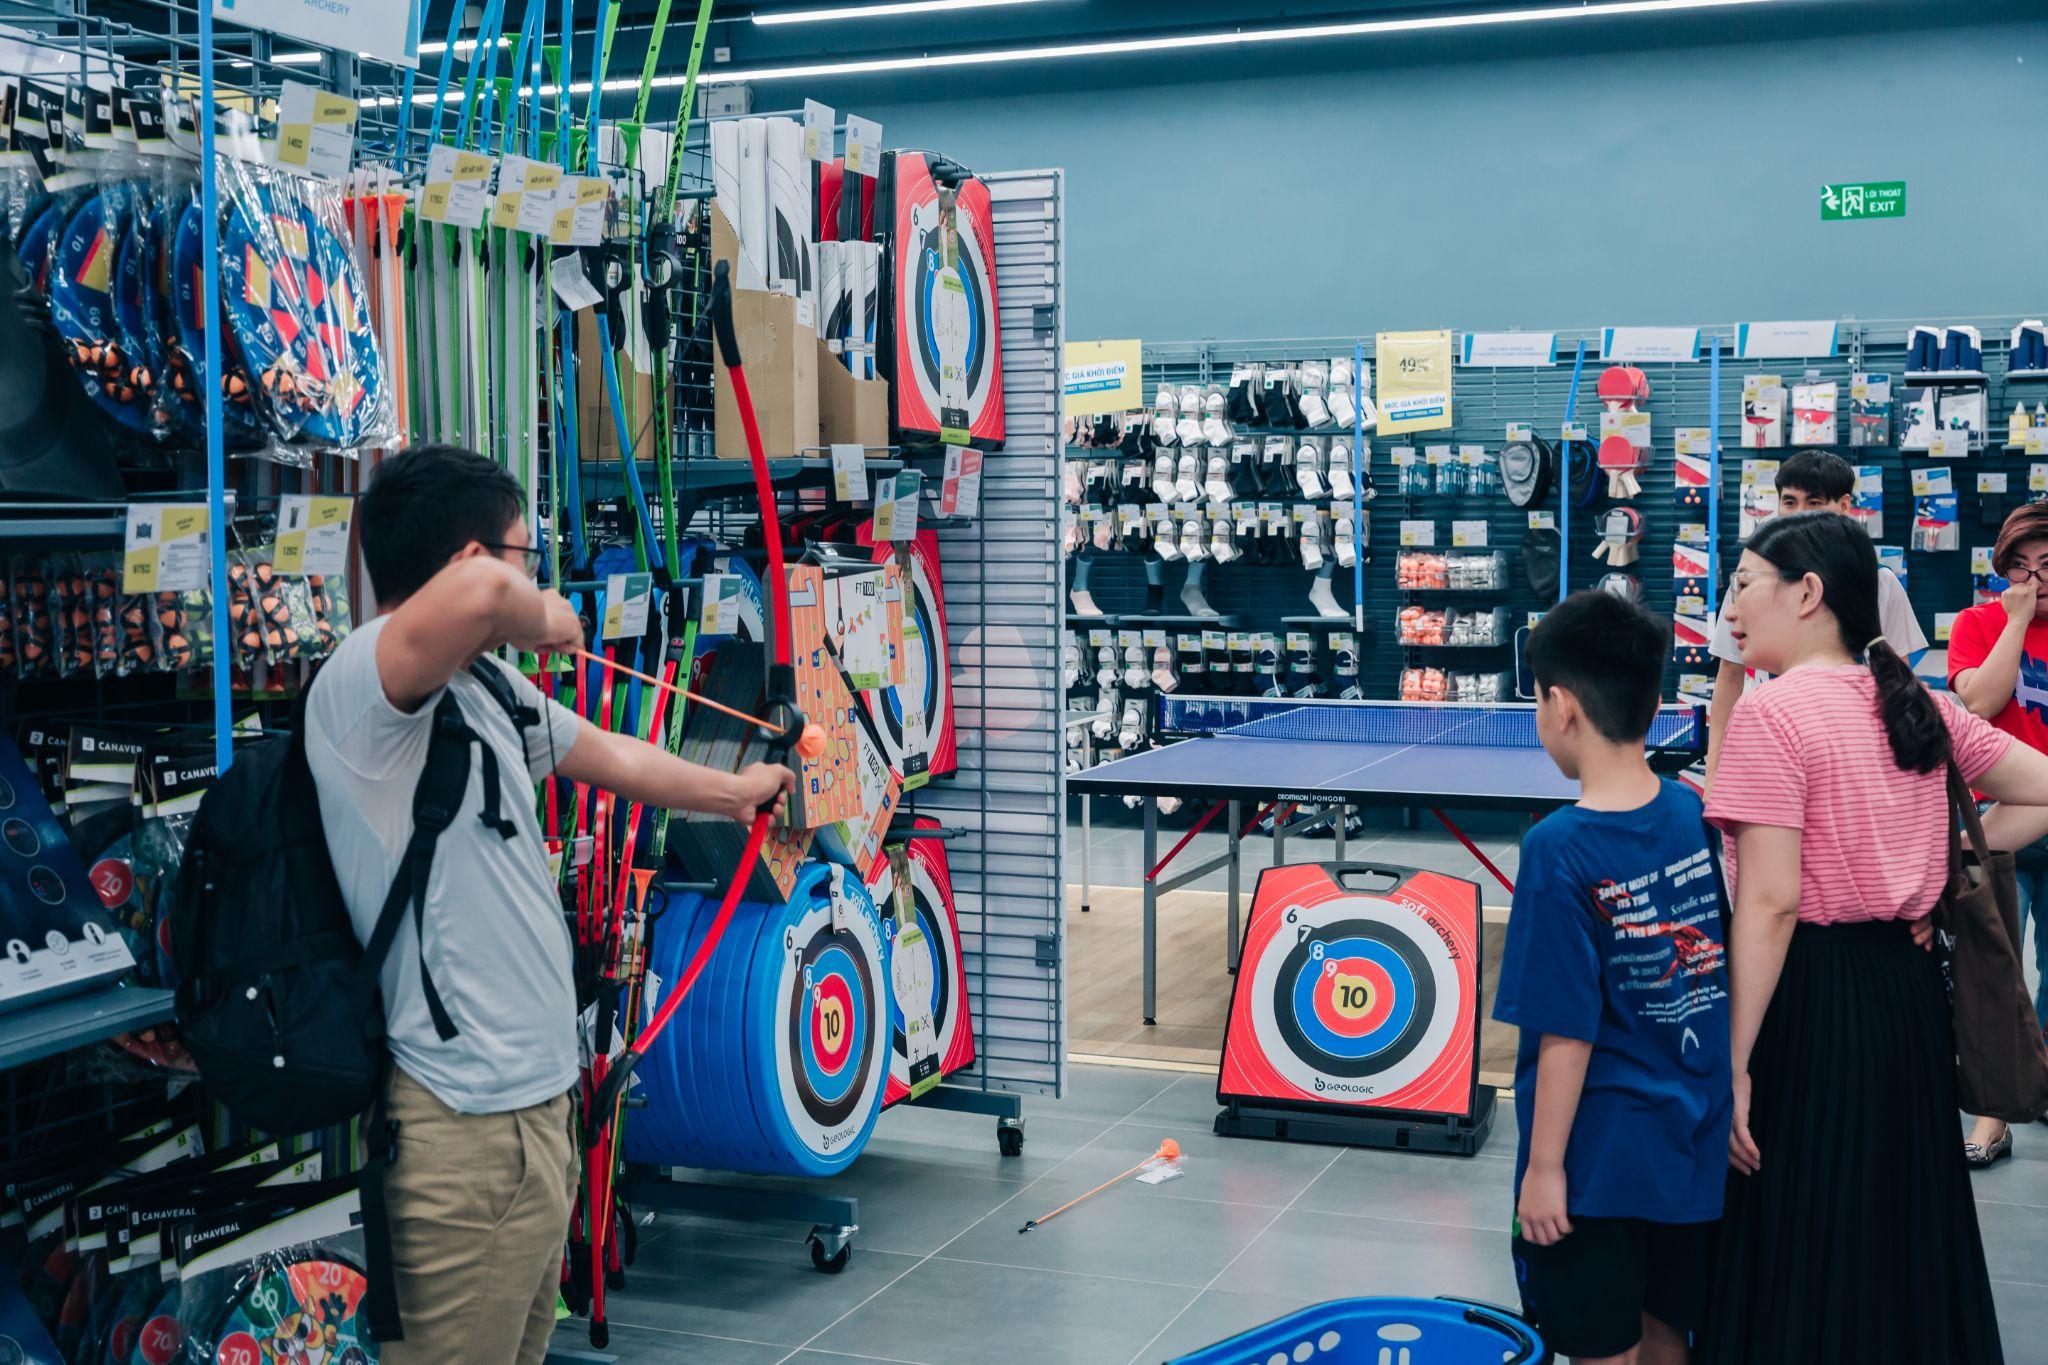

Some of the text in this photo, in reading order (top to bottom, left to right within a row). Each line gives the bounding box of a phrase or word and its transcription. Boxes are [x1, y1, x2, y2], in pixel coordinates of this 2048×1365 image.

[1869, 201, 1896, 212] EXIT
[913, 207, 919, 226] 6
[71, 234, 84, 251] 10
[921, 231, 926, 250] 7
[929, 252, 934, 271] 8
[181, 283, 190, 300] 10
[855, 582, 874, 595] FT 100
[1313, 795, 1346, 803] PONGORI
[100, 870, 122, 895] 70
[1598, 871, 1659, 900] SPENT MOST OF
[1617, 898, 1631, 910] ITS
[1286, 908, 1297, 924] 6
[850, 892, 885, 961] soft archery
[884, 921, 891, 940] 8
[1300, 926, 1311, 943] 7
[1401, 898, 1461, 961] soft archery
[1615, 929, 1625, 940] IN
[1627, 926, 1646, 938] THE
[786, 929, 793, 950] 6
[796, 949, 802, 972] 7
[1312, 944, 1324, 960] 8
[805, 968, 812, 989] 8
[1325, 961, 1337, 978] 9
[1679, 966, 1696, 978] Late
[814, 987, 821, 1008] 9
[1340, 985, 1367, 1009] 10
[824, 1009, 840, 1040] 10
[32, 1183, 74, 1206] CANAVERAL
[141, 1207, 197, 1222] CANAVERAL
[192, 1222, 240, 1244] CANAVERAL
[319, 1262, 342, 1286] 20
[152, 1330, 171, 1349] 70
[230, 1347, 250, 1365] 70
